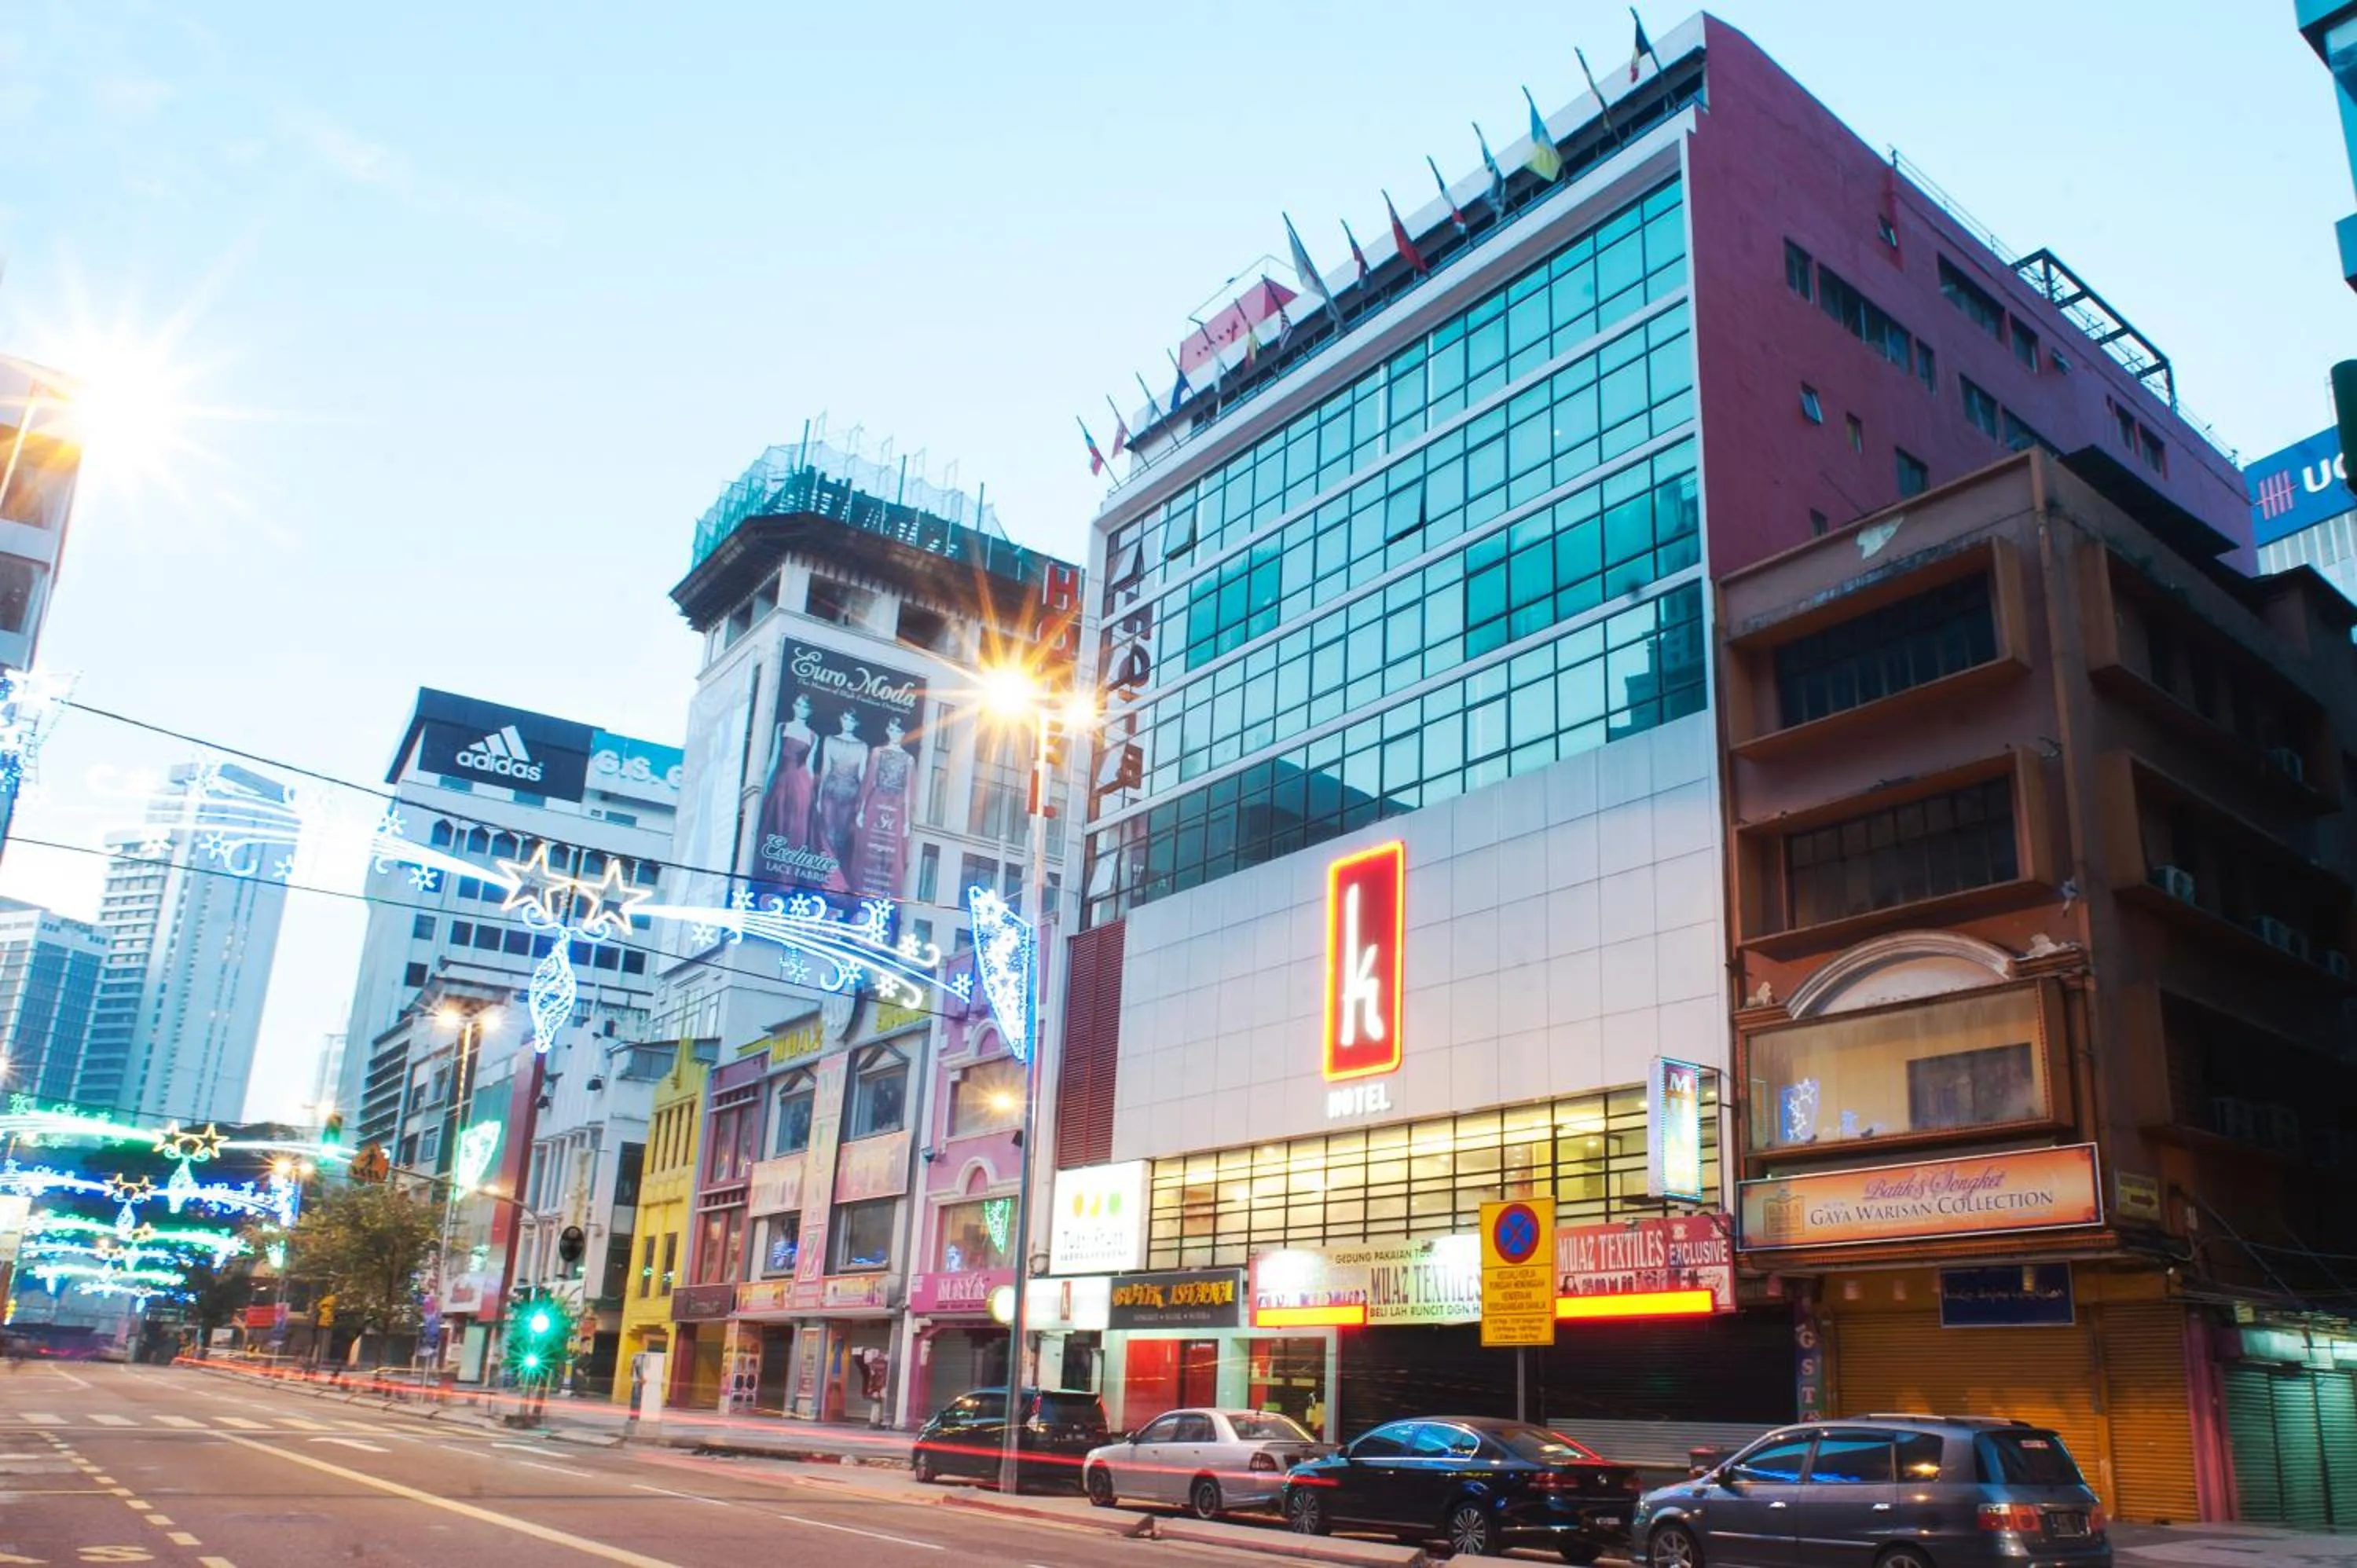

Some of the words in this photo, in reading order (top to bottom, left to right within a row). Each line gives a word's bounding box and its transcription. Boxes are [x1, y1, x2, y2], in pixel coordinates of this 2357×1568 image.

[791, 647, 847, 687] Euro
[847, 667, 917, 708] Moda
[1026, 562, 1080, 819] HOEL
[455, 749, 543, 782] adidas
[1328, 1083, 1391, 1119] HOTEL
[1930, 1167, 2006, 1196] Songket
[1810, 1208, 1852, 1226] GAYA
[1856, 1203, 1931, 1221] WARISAN
[1937, 1191, 2054, 1214] COLLECTION
[1335, 1251, 1372, 1264] GEDUNG
[1374, 1248, 1413, 1261] PAKAIAN
[1558, 1234, 1596, 1272] MUAZ
[1598, 1229, 1666, 1269] TEXTILES
[1668, 1239, 1728, 1266] EXCLUSIVE
[1370, 1266, 1409, 1306] MUAZ
